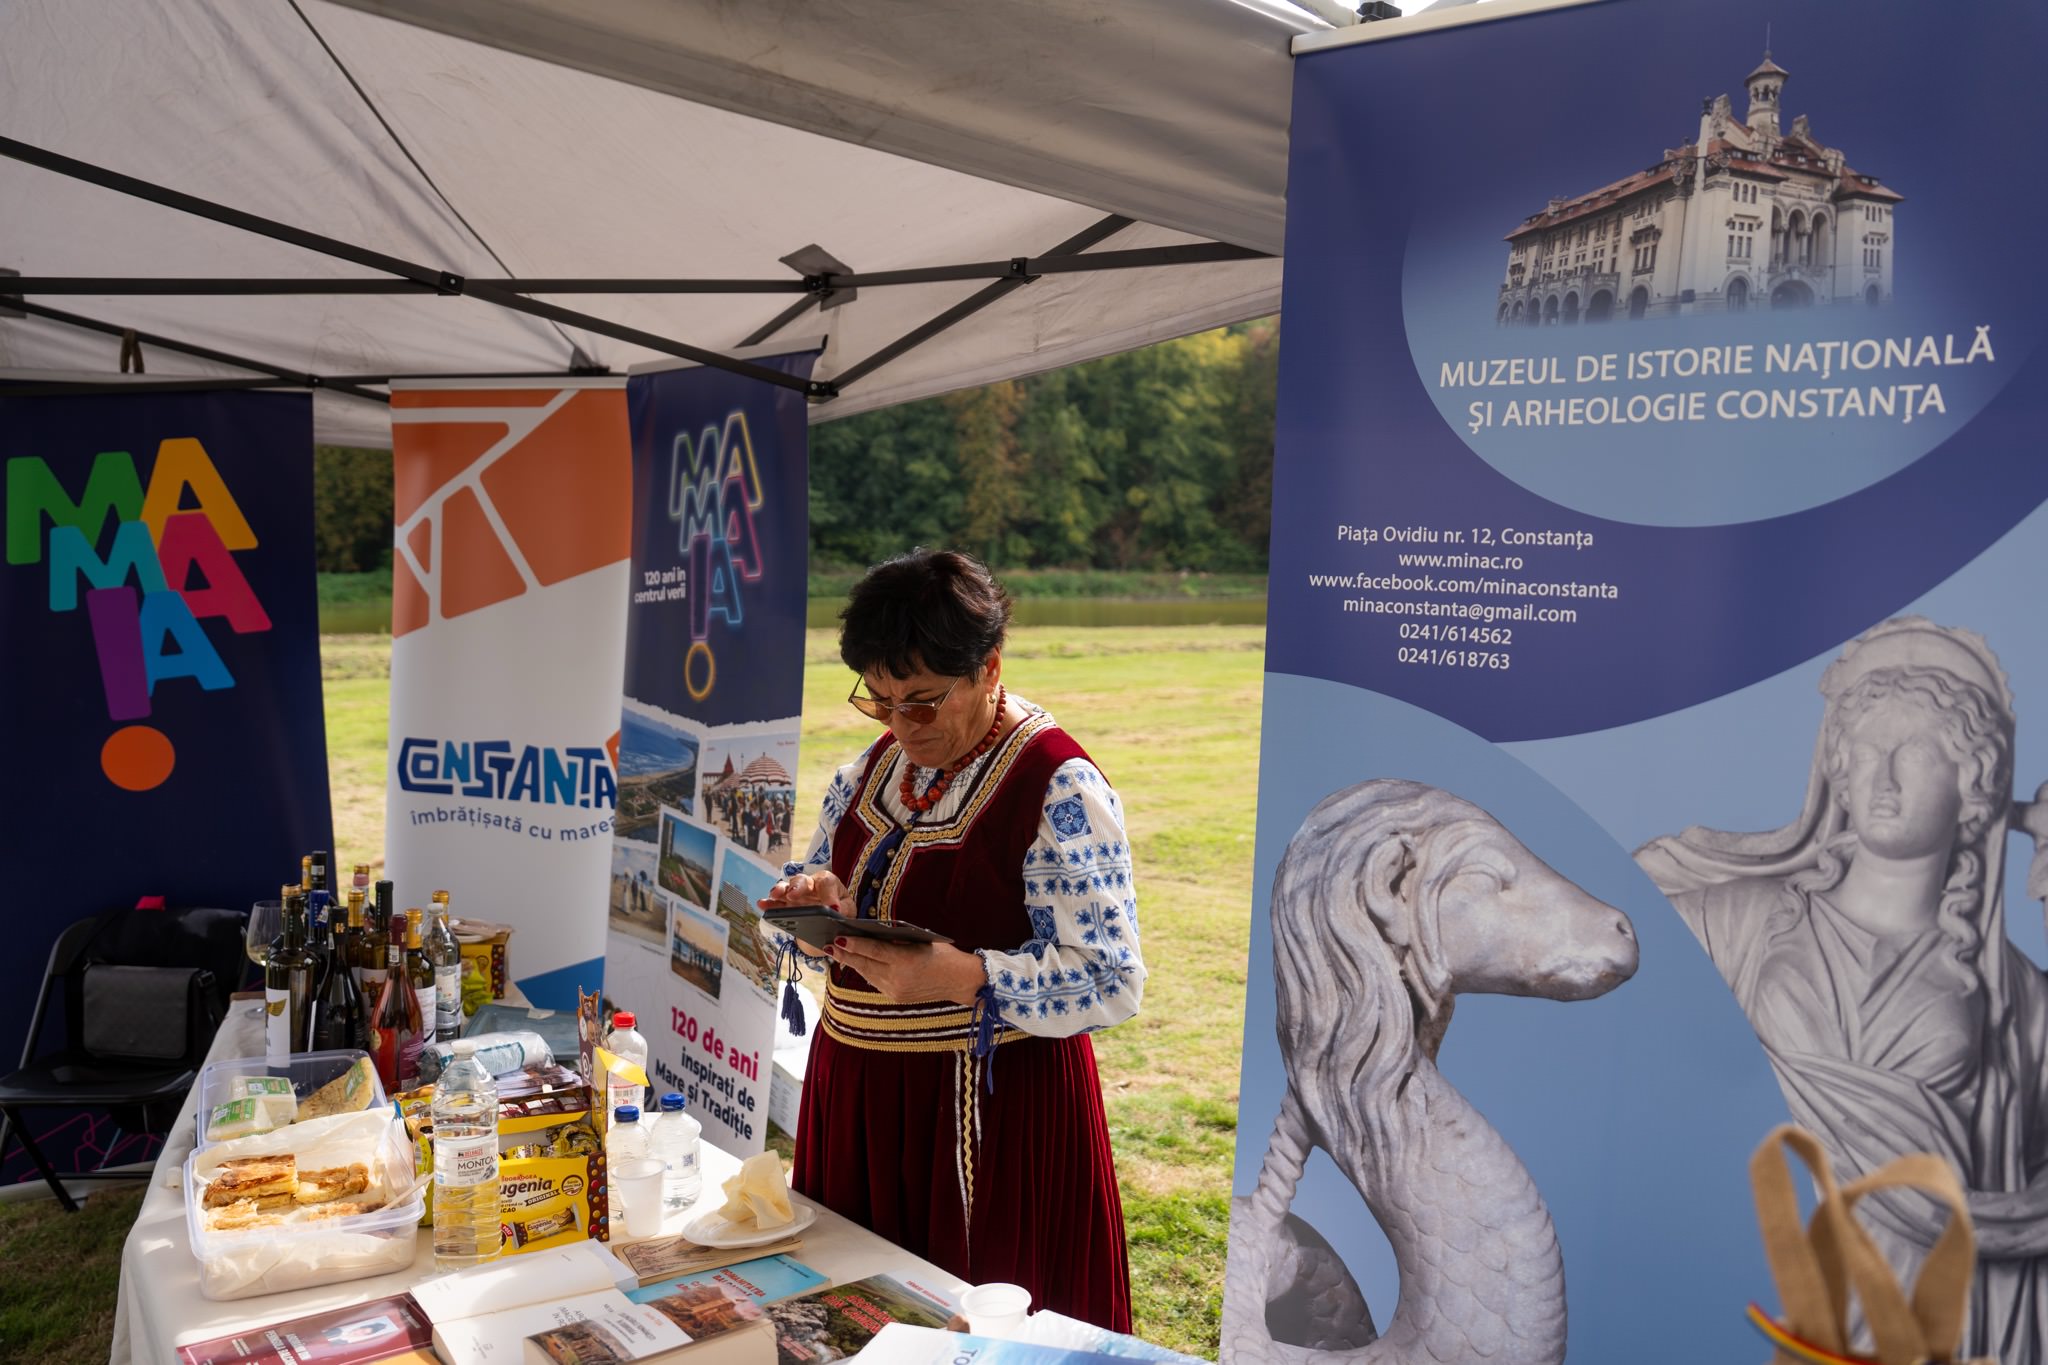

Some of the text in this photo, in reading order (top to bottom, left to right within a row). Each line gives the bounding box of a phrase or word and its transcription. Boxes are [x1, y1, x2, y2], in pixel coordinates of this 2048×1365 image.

[1440, 357, 1565, 387] MUZEUL
[1576, 353, 1617, 382] DE
[1628, 345, 1753, 379] ISTORIE
[1502, 392, 1706, 426] ARHEOLOGIE
[1383, 526, 1439, 543] Ovidiu
[1443, 531, 1465, 543] nr.
[1471, 528, 1496, 546] 12,
[1399, 553, 1523, 570] www.minac.ro
[644, 570, 661, 586] 120
[662, 566, 676, 584] ani
[1309, 573, 1618, 599] www.facebook.com/minaconstanta
[634, 582, 686, 604] centrul verii
[1343, 597, 1578, 623] minaconstanta@gmail.com
[1400, 623, 1512, 645] 0241/614562
[1398, 647, 1510, 669] 0241/618763
[410, 805, 523, 833] îmbrățișată
[529, 824, 552, 840] cu
[671, 1006, 759, 1082] 120 de ani
[681, 1046, 734, 1102] inspirați
[737, 1087, 755, 1112] de
[655, 1058, 685, 1092] Mare
[701, 1089, 752, 1140] Tradiție
[500, 1178, 553, 1198] ugenia
